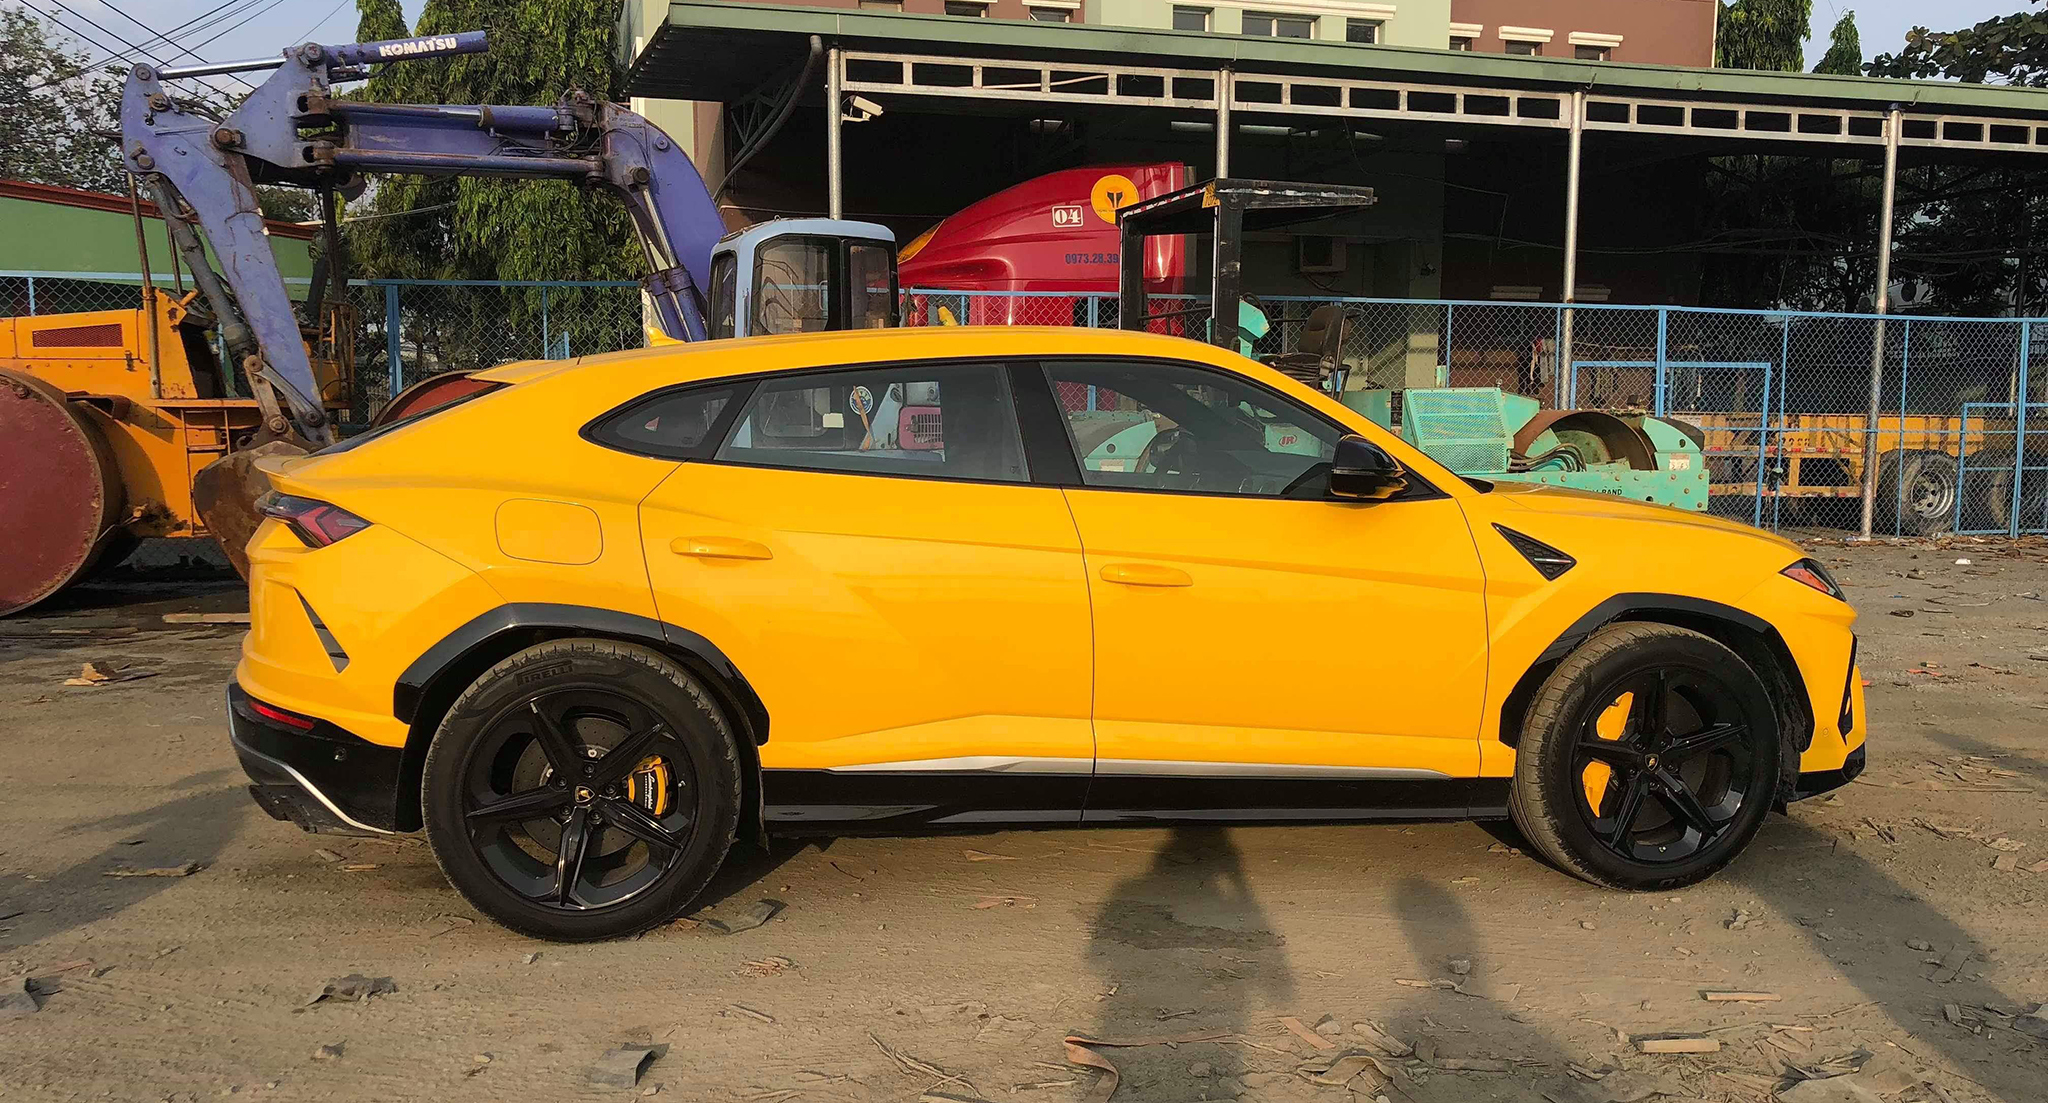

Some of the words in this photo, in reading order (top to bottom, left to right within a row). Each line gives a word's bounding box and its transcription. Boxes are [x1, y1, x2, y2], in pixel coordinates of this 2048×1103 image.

[379, 37, 458, 57] KOMATSU
[1054, 208, 1082, 224] 04
[1065, 253, 1120, 264] 0973.28.39
[515, 660, 573, 686] PIRELLI
